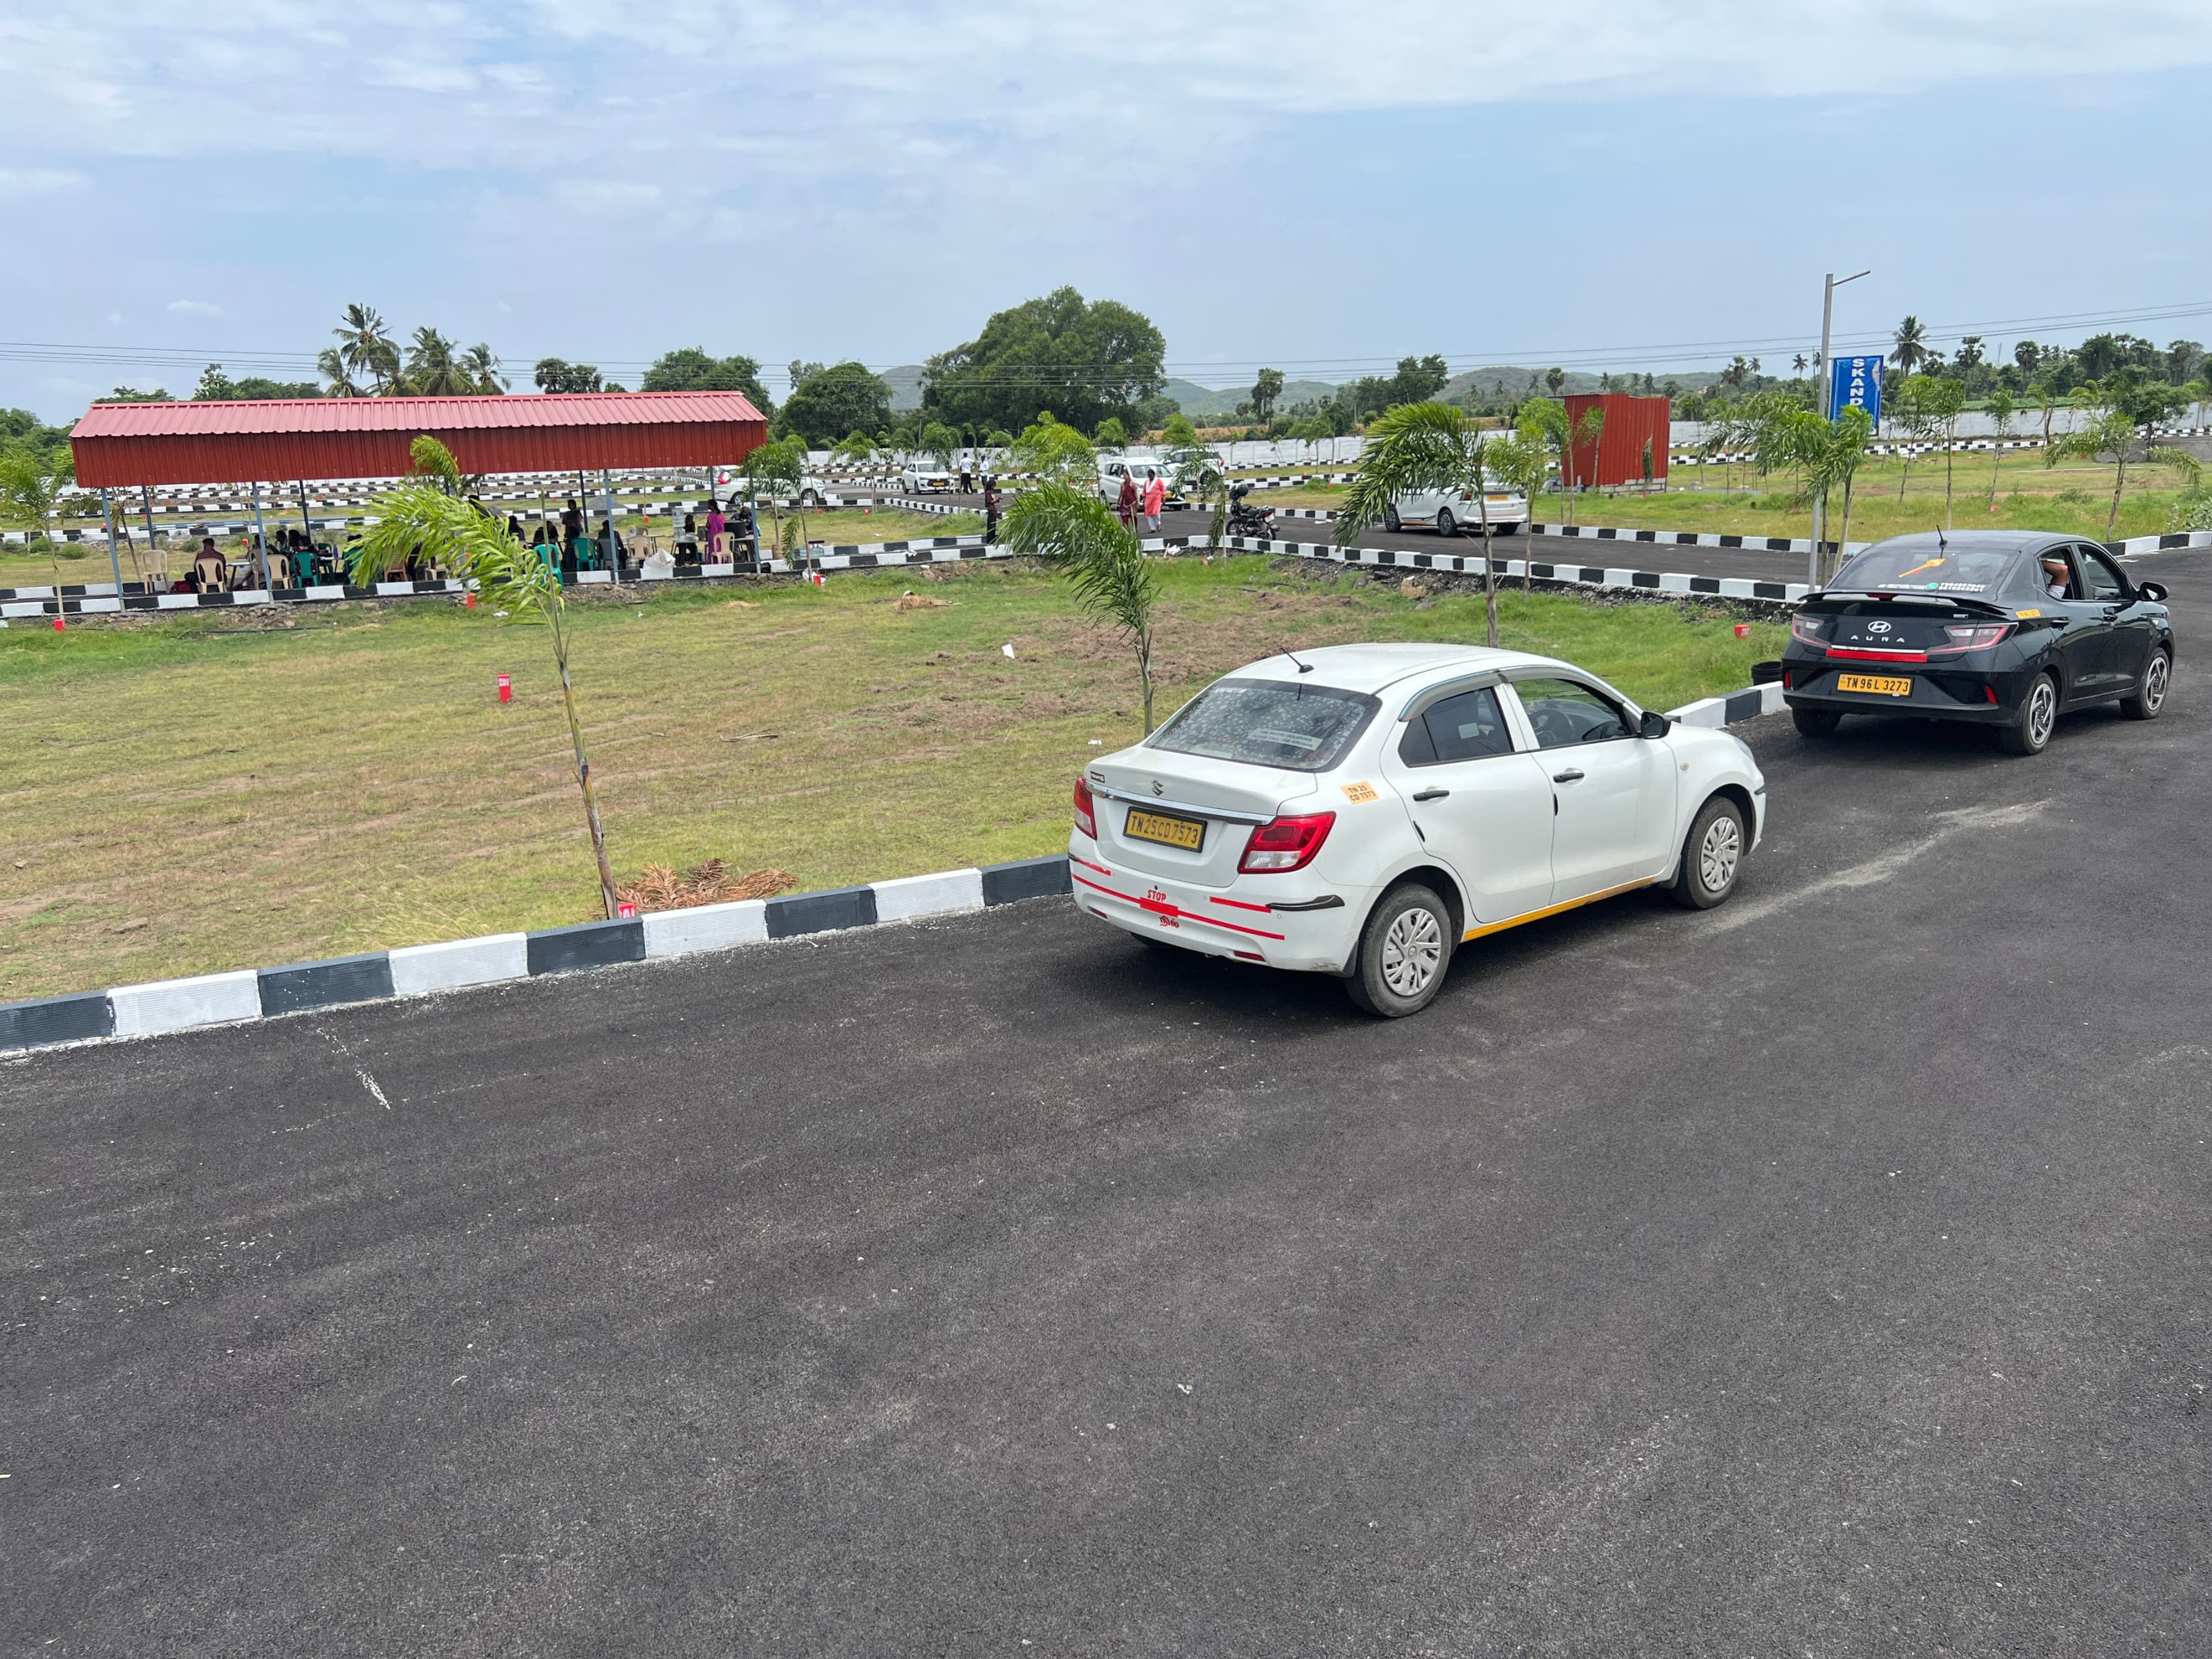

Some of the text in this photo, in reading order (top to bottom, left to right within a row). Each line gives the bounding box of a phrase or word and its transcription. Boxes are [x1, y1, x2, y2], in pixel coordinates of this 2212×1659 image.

[1850, 635, 1905, 643] AURA
[498, 677, 509, 686] 201
[1846, 677, 1859, 688] TN
[1883, 680, 1909, 692] 3273
[1359, 790, 1376, 798] 7573
[1147, 889, 1166, 901] STOP
